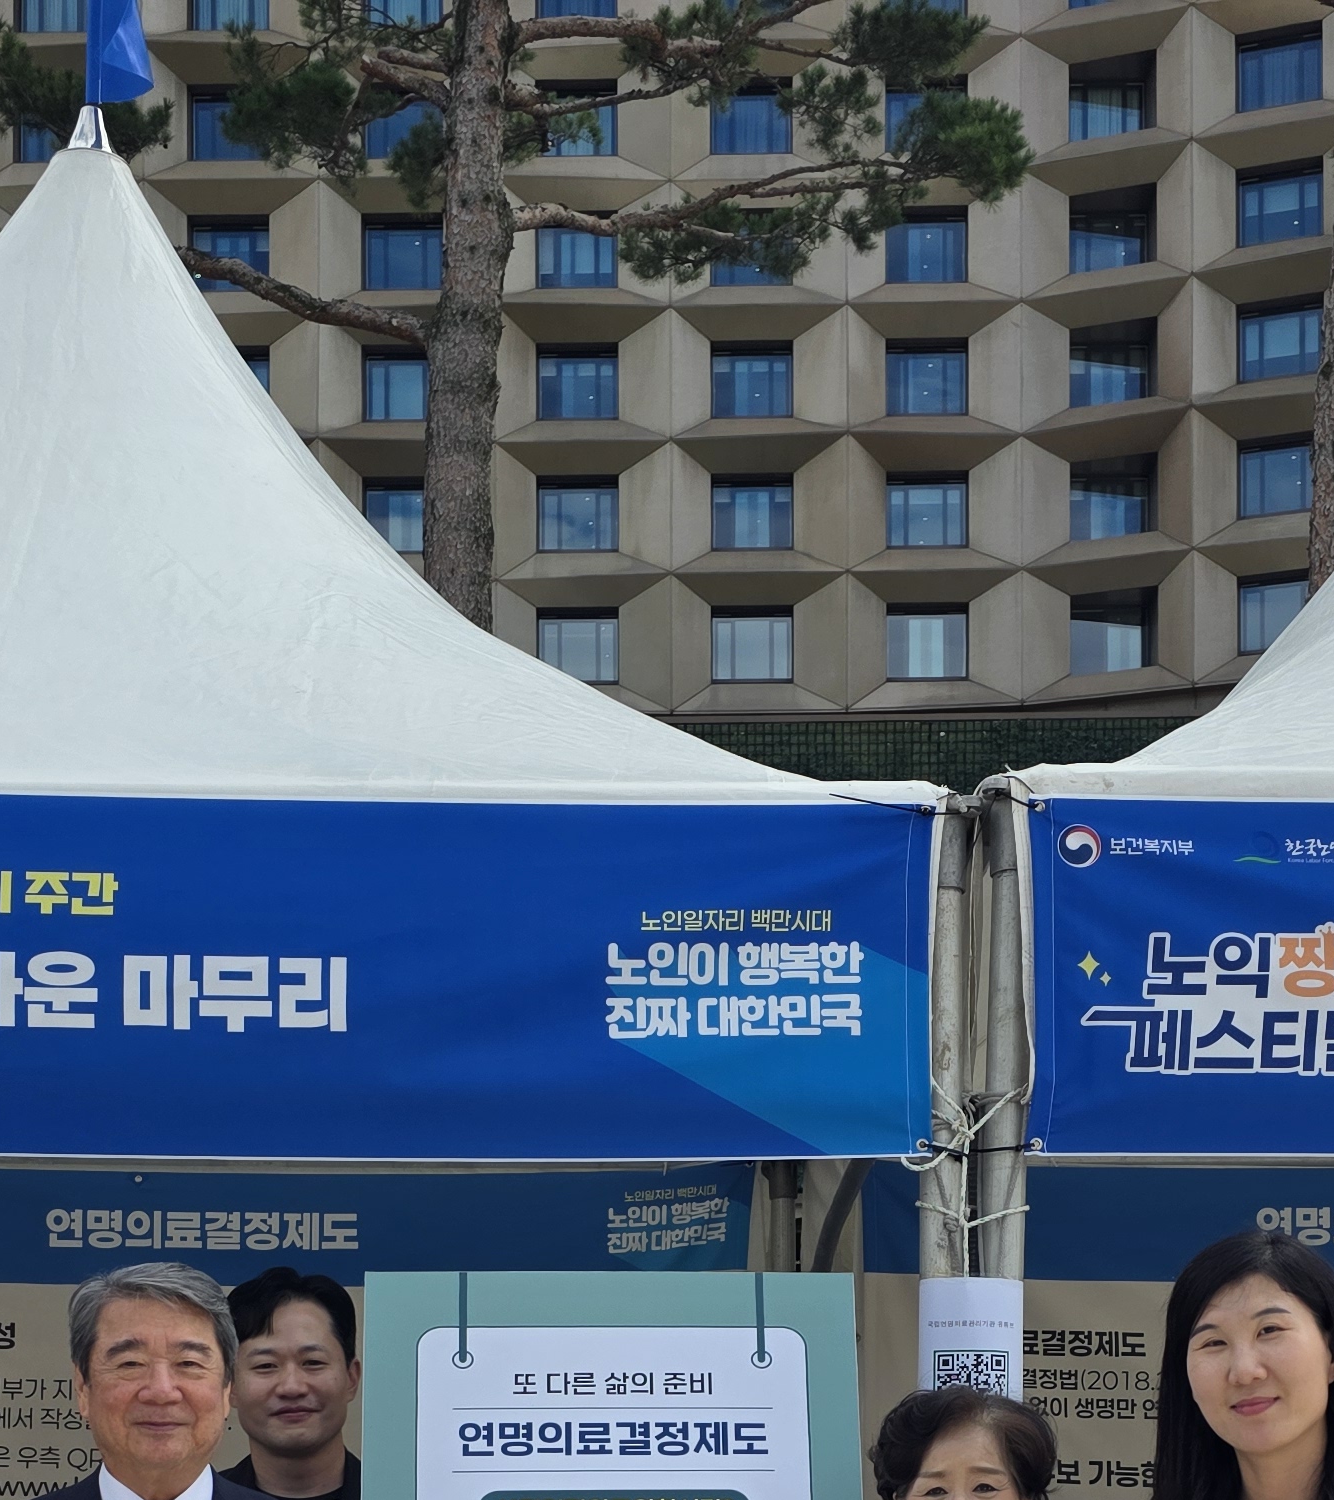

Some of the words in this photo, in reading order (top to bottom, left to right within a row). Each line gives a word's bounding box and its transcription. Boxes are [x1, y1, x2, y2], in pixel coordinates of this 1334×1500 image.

[1109, 837, 1195, 857] 보건복지부
[24, 870, 119, 916] 주간
[640, 908, 745, 932] 노인일자리
[751, 908, 832, 934] 백만시대
[605, 942, 729, 987] 노인이
[737, 941, 864, 987] 행복한
[123, 953, 348, 1033] 마무리
[605, 996, 691, 1039] 진짜
[698, 992, 862, 1038] 대한민국
[623, 1187, 675, 1202] 노인일자리
[677, 1183, 717, 1199] 백만시대
[45, 1207, 359, 1251] 연명의료결정제도
[606, 1204, 669, 1231] 노인이
[671, 1197, 730, 1223] 행복한
[606, 1230, 649, 1254] 진짜
[650, 1222, 727, 1252] 대한민국
[512, 1372, 538, 1396] 또
[546, 1371, 597, 1396] 다른
[604, 1371, 655, 1396] 삶의
[662, 1371, 714, 1396] 준비
[458, 1421, 769, 1457] 연명의료결정제도
